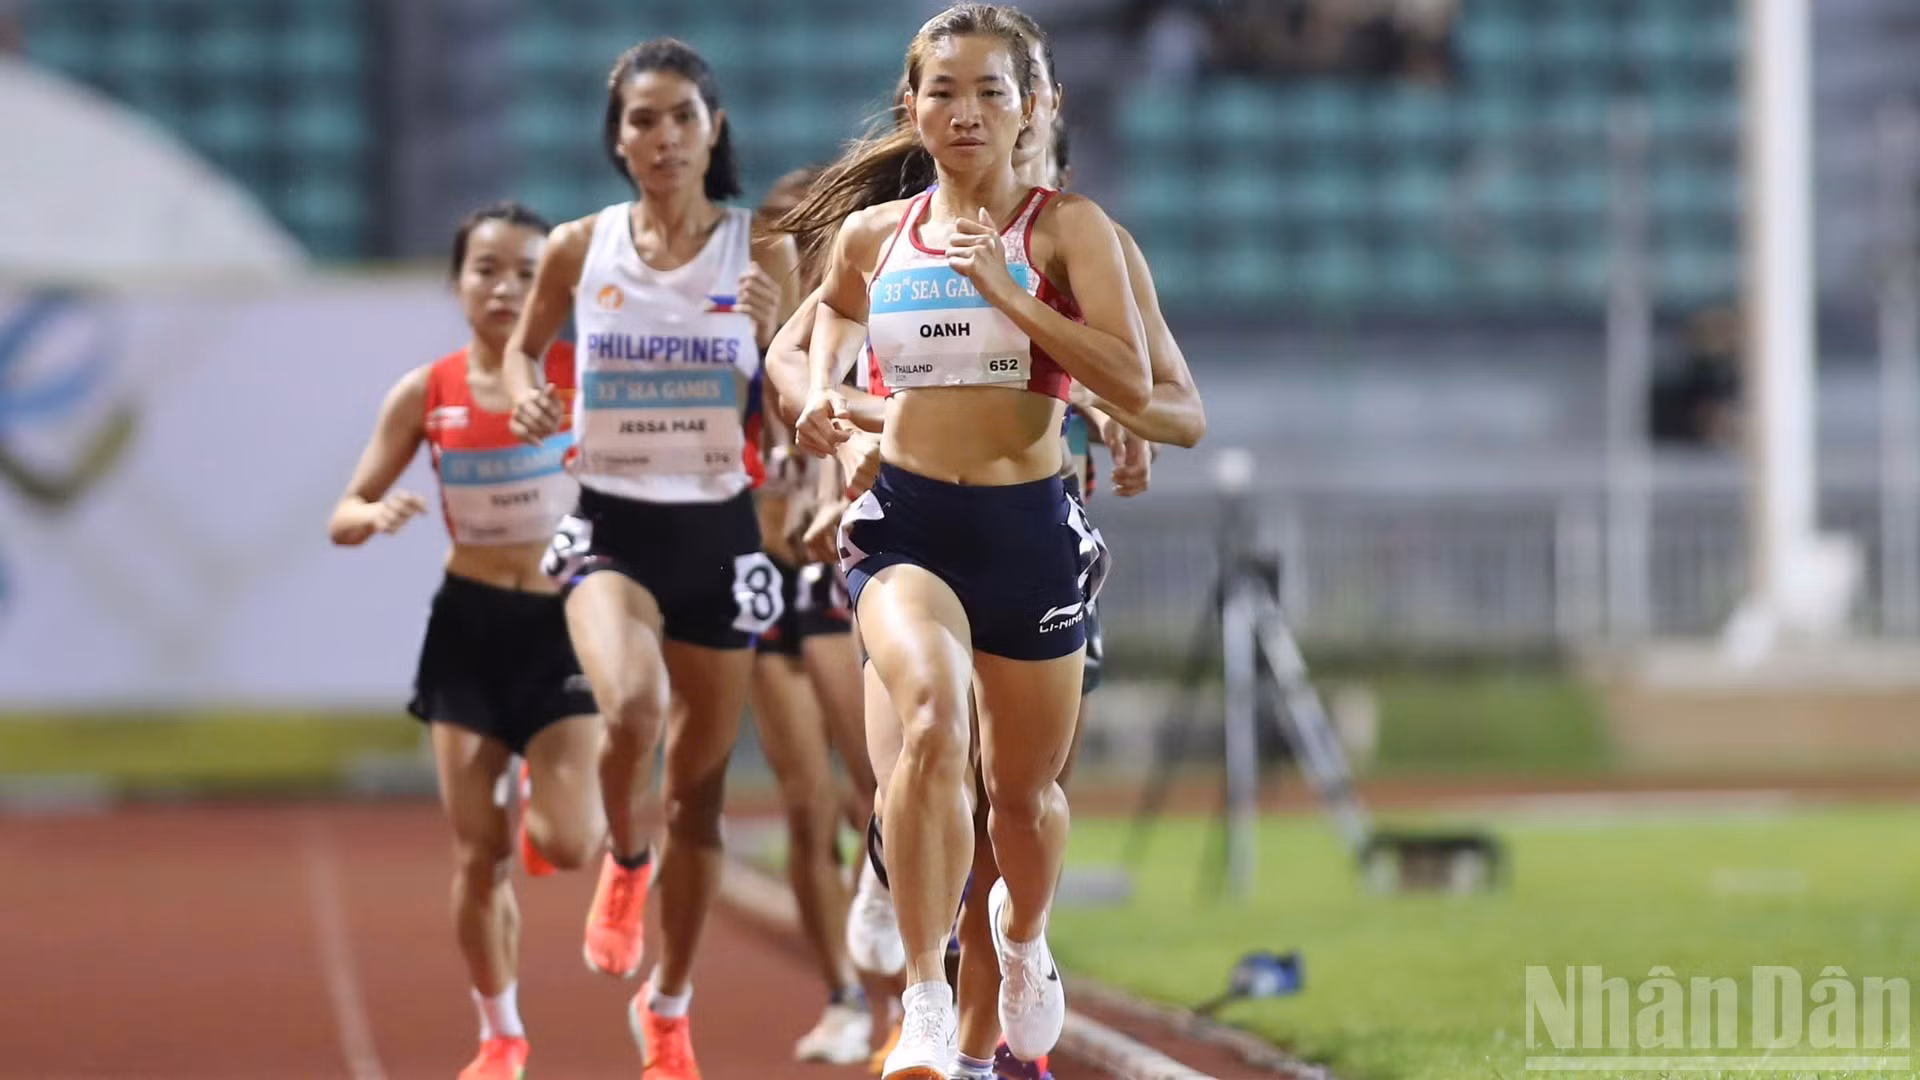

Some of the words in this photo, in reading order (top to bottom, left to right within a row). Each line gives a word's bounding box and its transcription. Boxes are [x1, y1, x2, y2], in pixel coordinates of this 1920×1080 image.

[911, 280, 940, 300] SEA
[919, 322, 971, 338] OANH
[588, 333, 740, 364] PHILIPPINES
[894, 363, 933, 374] THAILAND
[989, 359, 1019, 372] 652
[627, 381, 657, 399] SEA
[662, 380, 720, 400] GAMES
[618, 419, 668, 434] JESSA
[671, 419, 706, 432] MAE
[745, 565, 775, 621] 8
[1039, 610, 1084, 634] LI-NING
